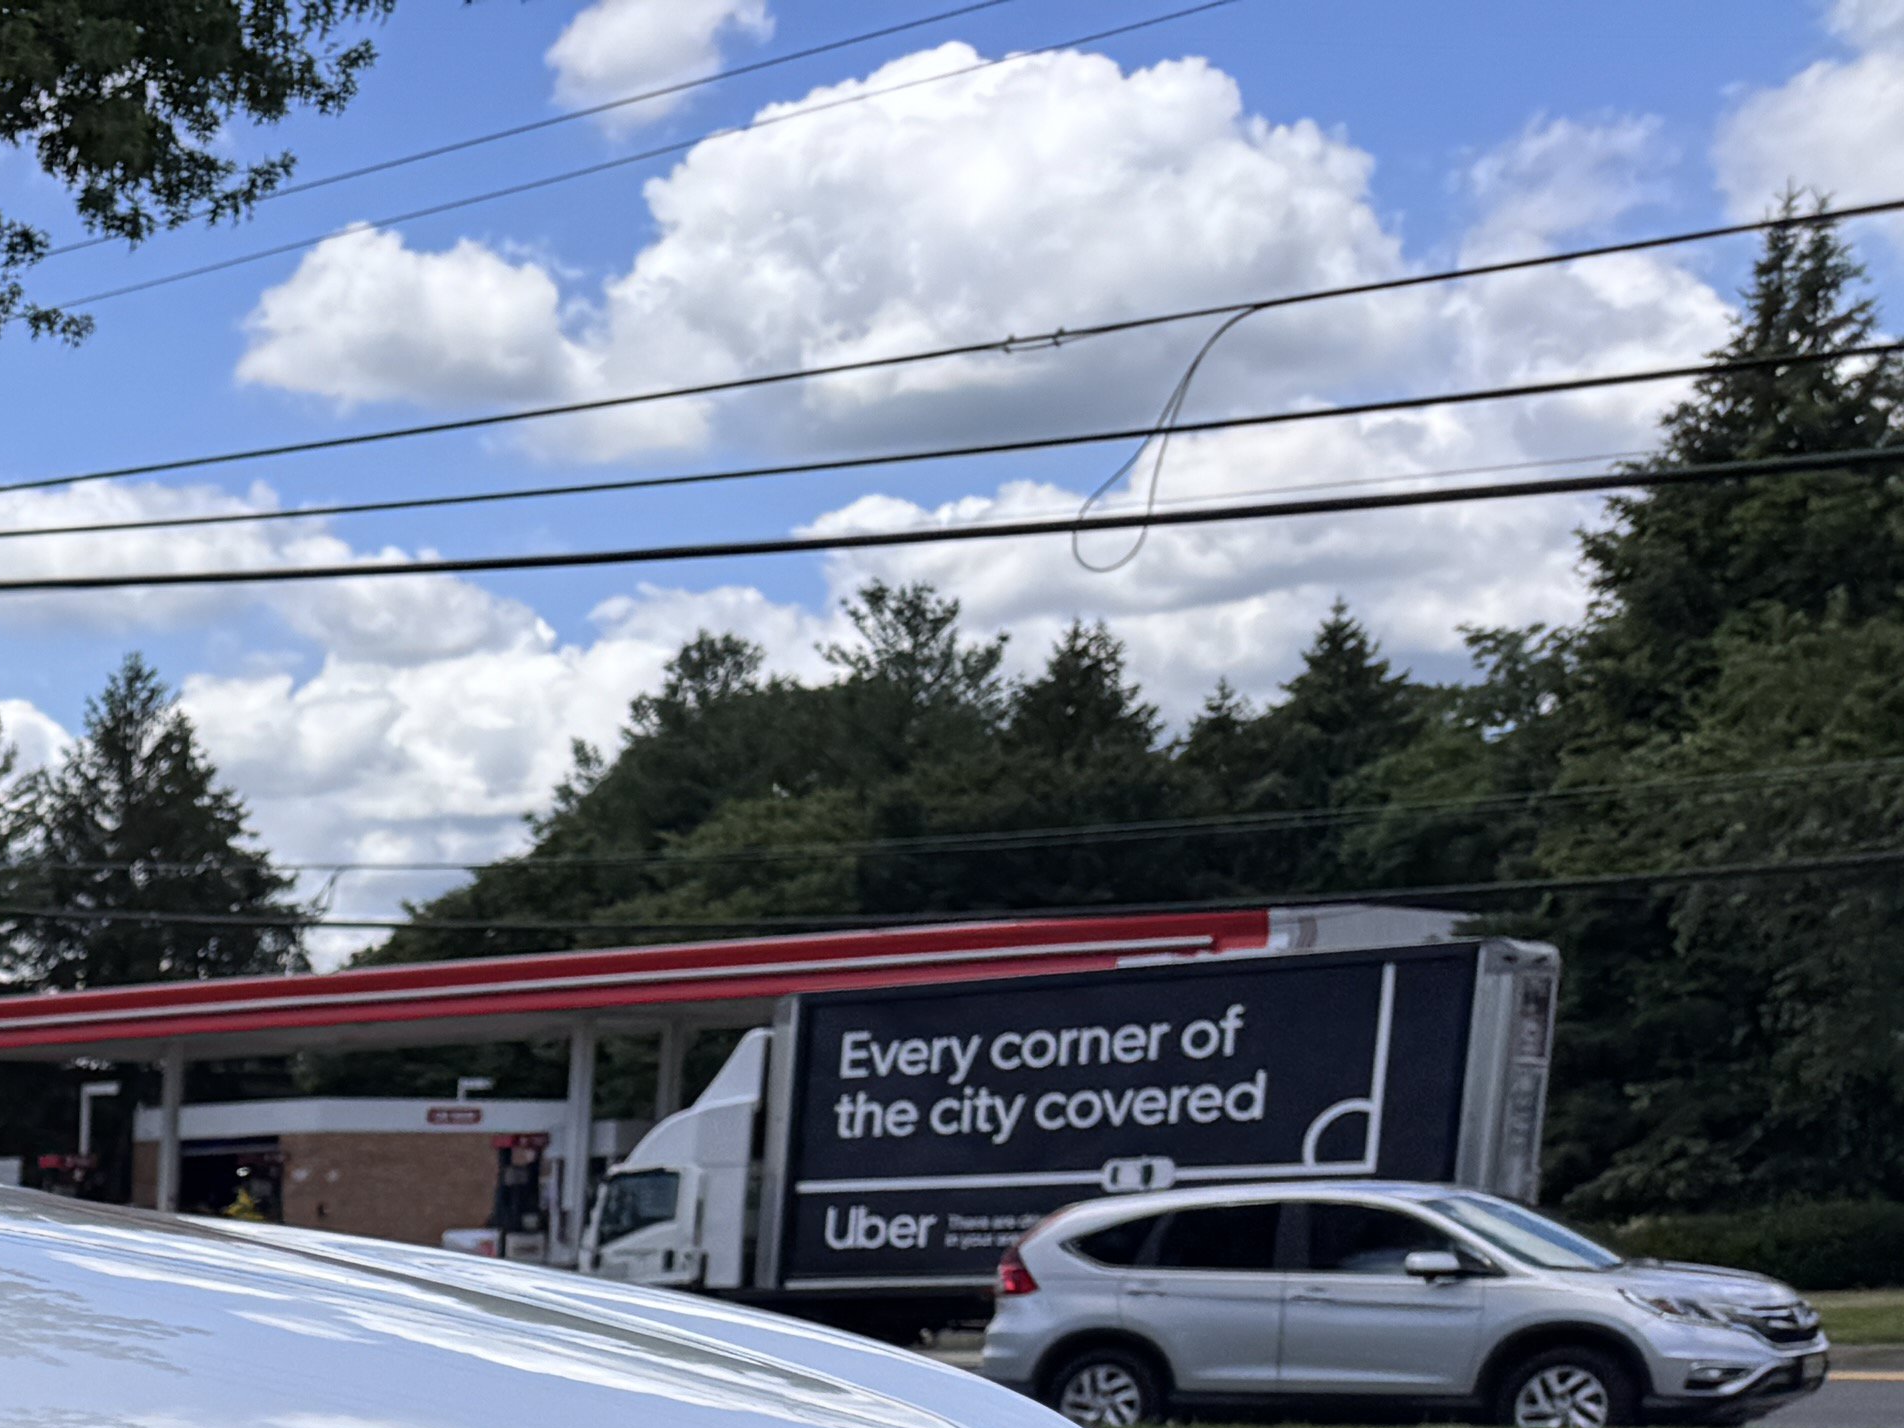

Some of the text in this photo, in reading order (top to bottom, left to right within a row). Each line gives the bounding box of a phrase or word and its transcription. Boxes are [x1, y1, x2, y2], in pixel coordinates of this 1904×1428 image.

[837, 1003, 1246, 1086] Every corner of
[835, 1070, 1267, 1144] the city covered
[824, 1204, 939, 1250] Uber
